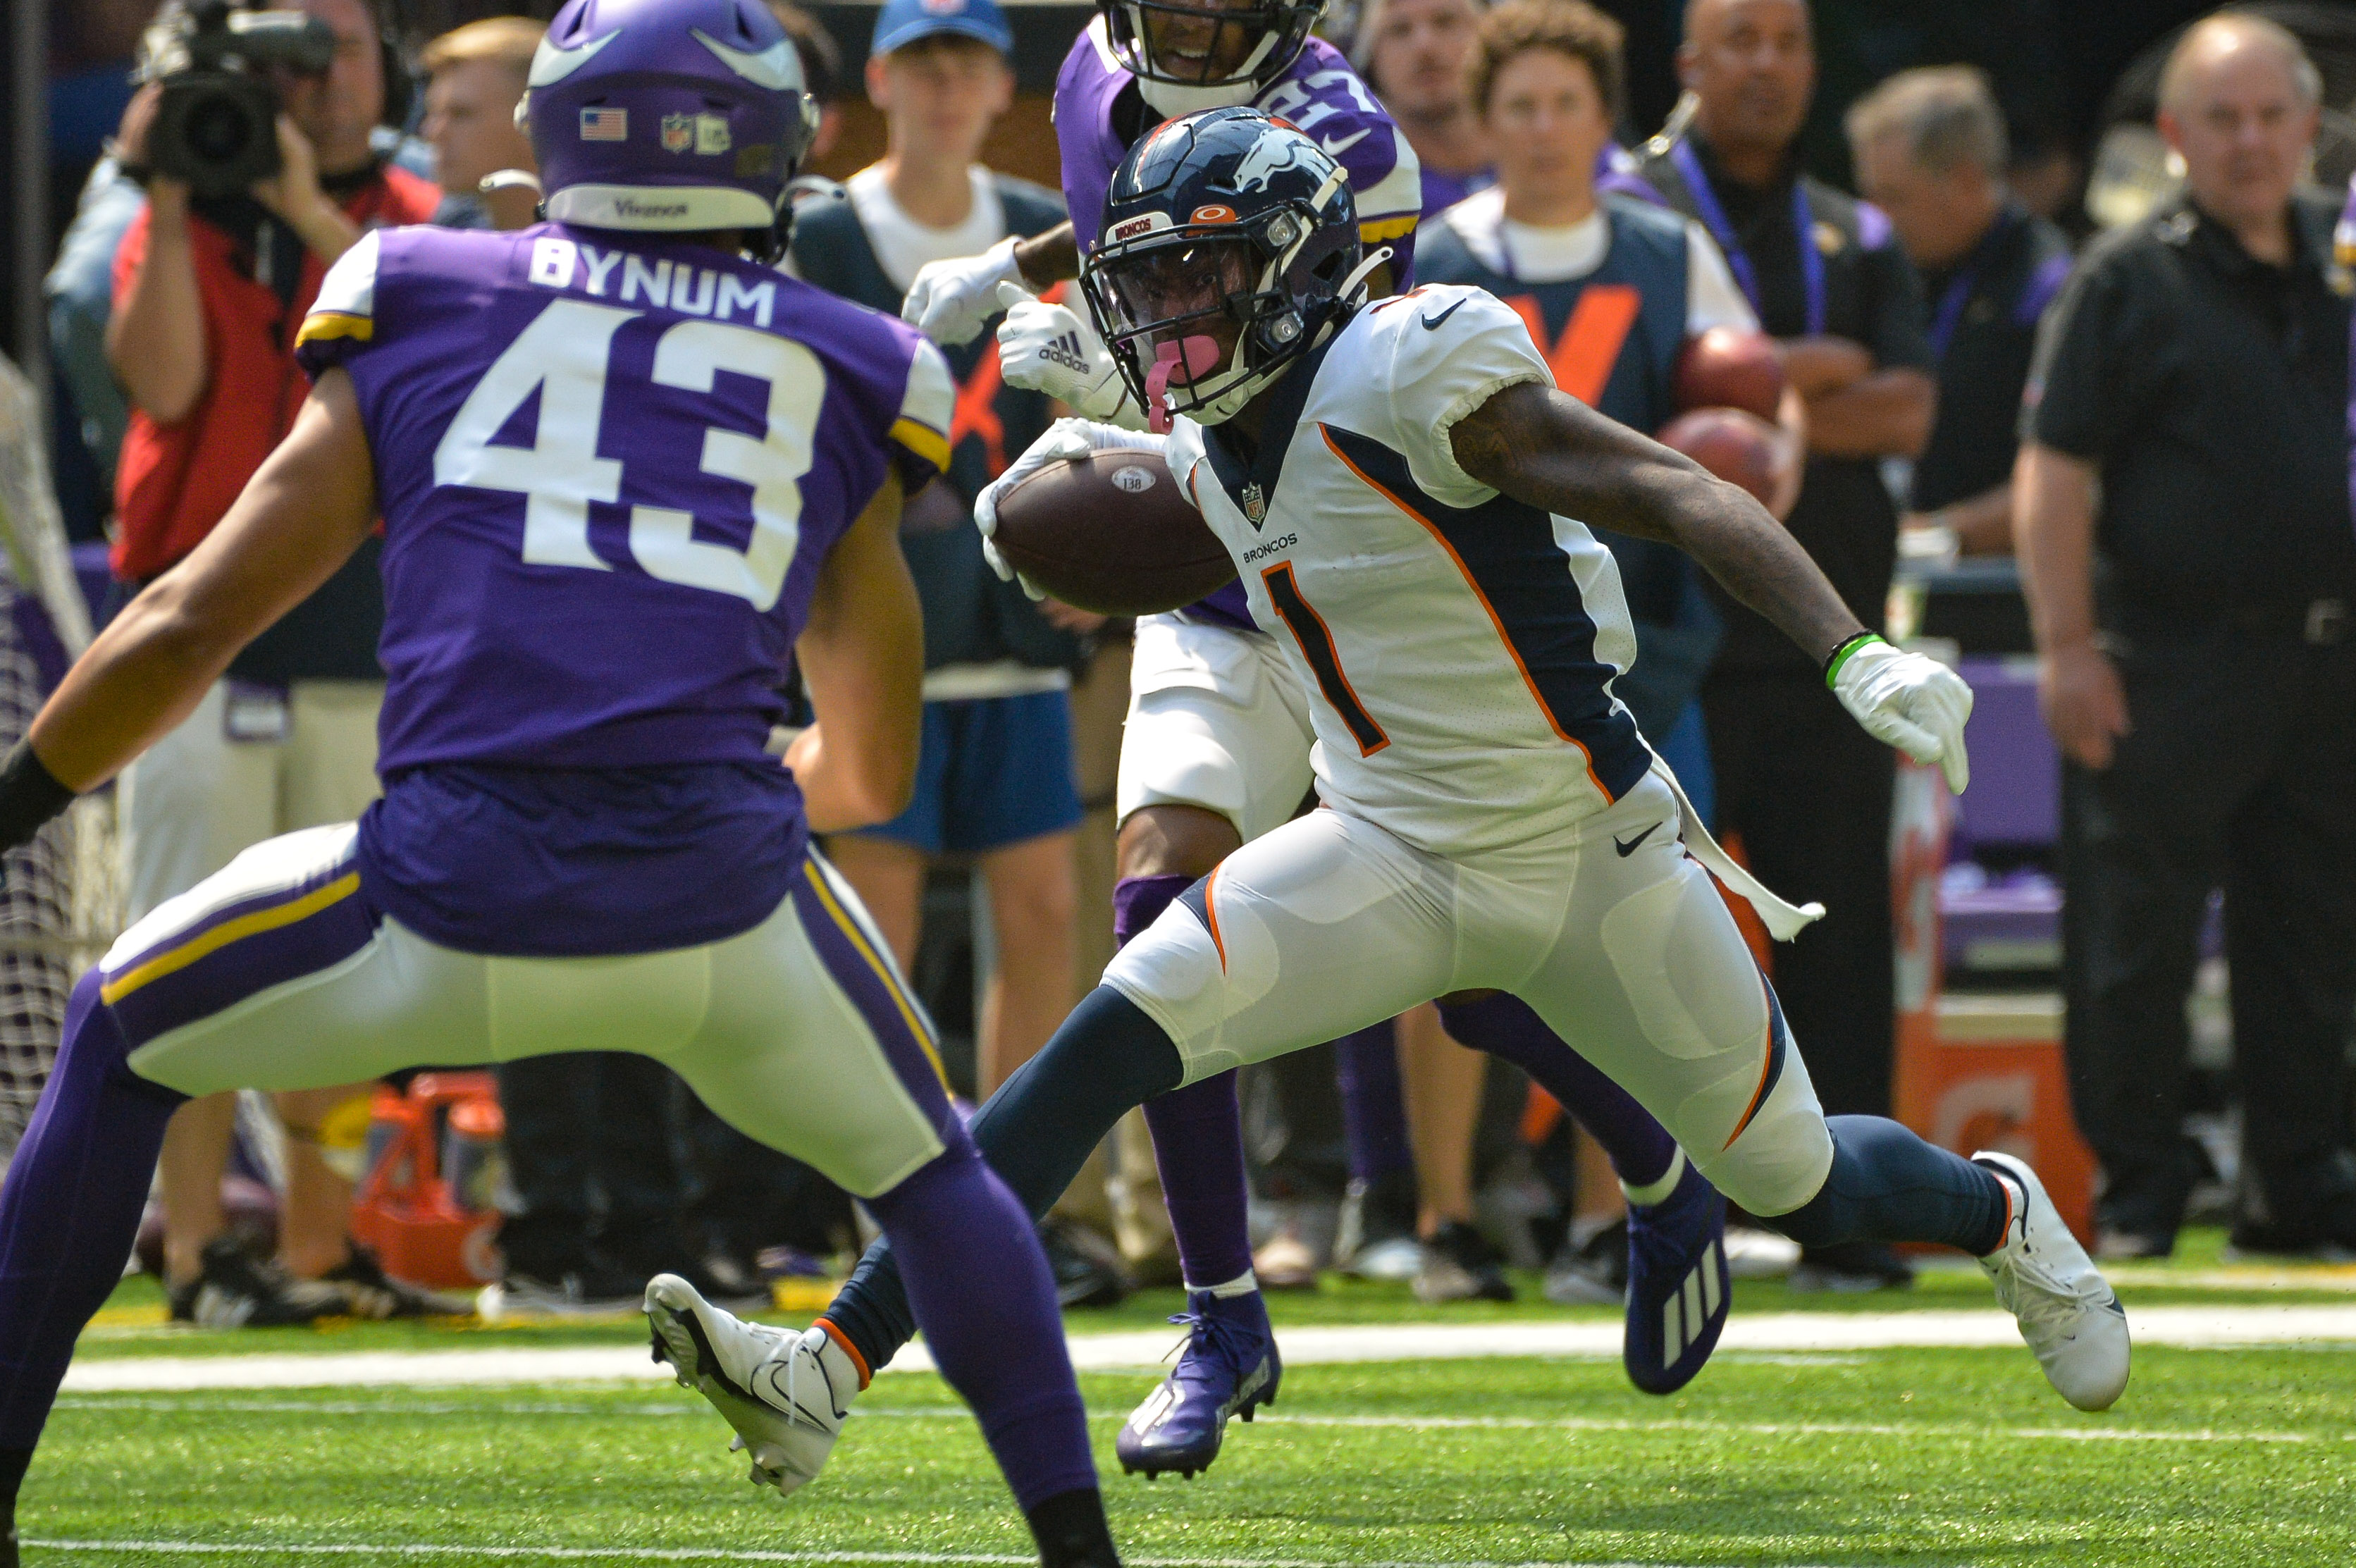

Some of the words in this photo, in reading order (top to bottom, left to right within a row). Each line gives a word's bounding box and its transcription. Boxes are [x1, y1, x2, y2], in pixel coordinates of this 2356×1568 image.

[1115, 218, 1151, 242] BRONCOS
[529, 237, 775, 328] BYNUM
[1039, 349, 1090, 375] adidas
[433, 297, 827, 613] 43
[1243, 533, 1297, 564] BRONCOS
[1260, 560, 1391, 758] 1
